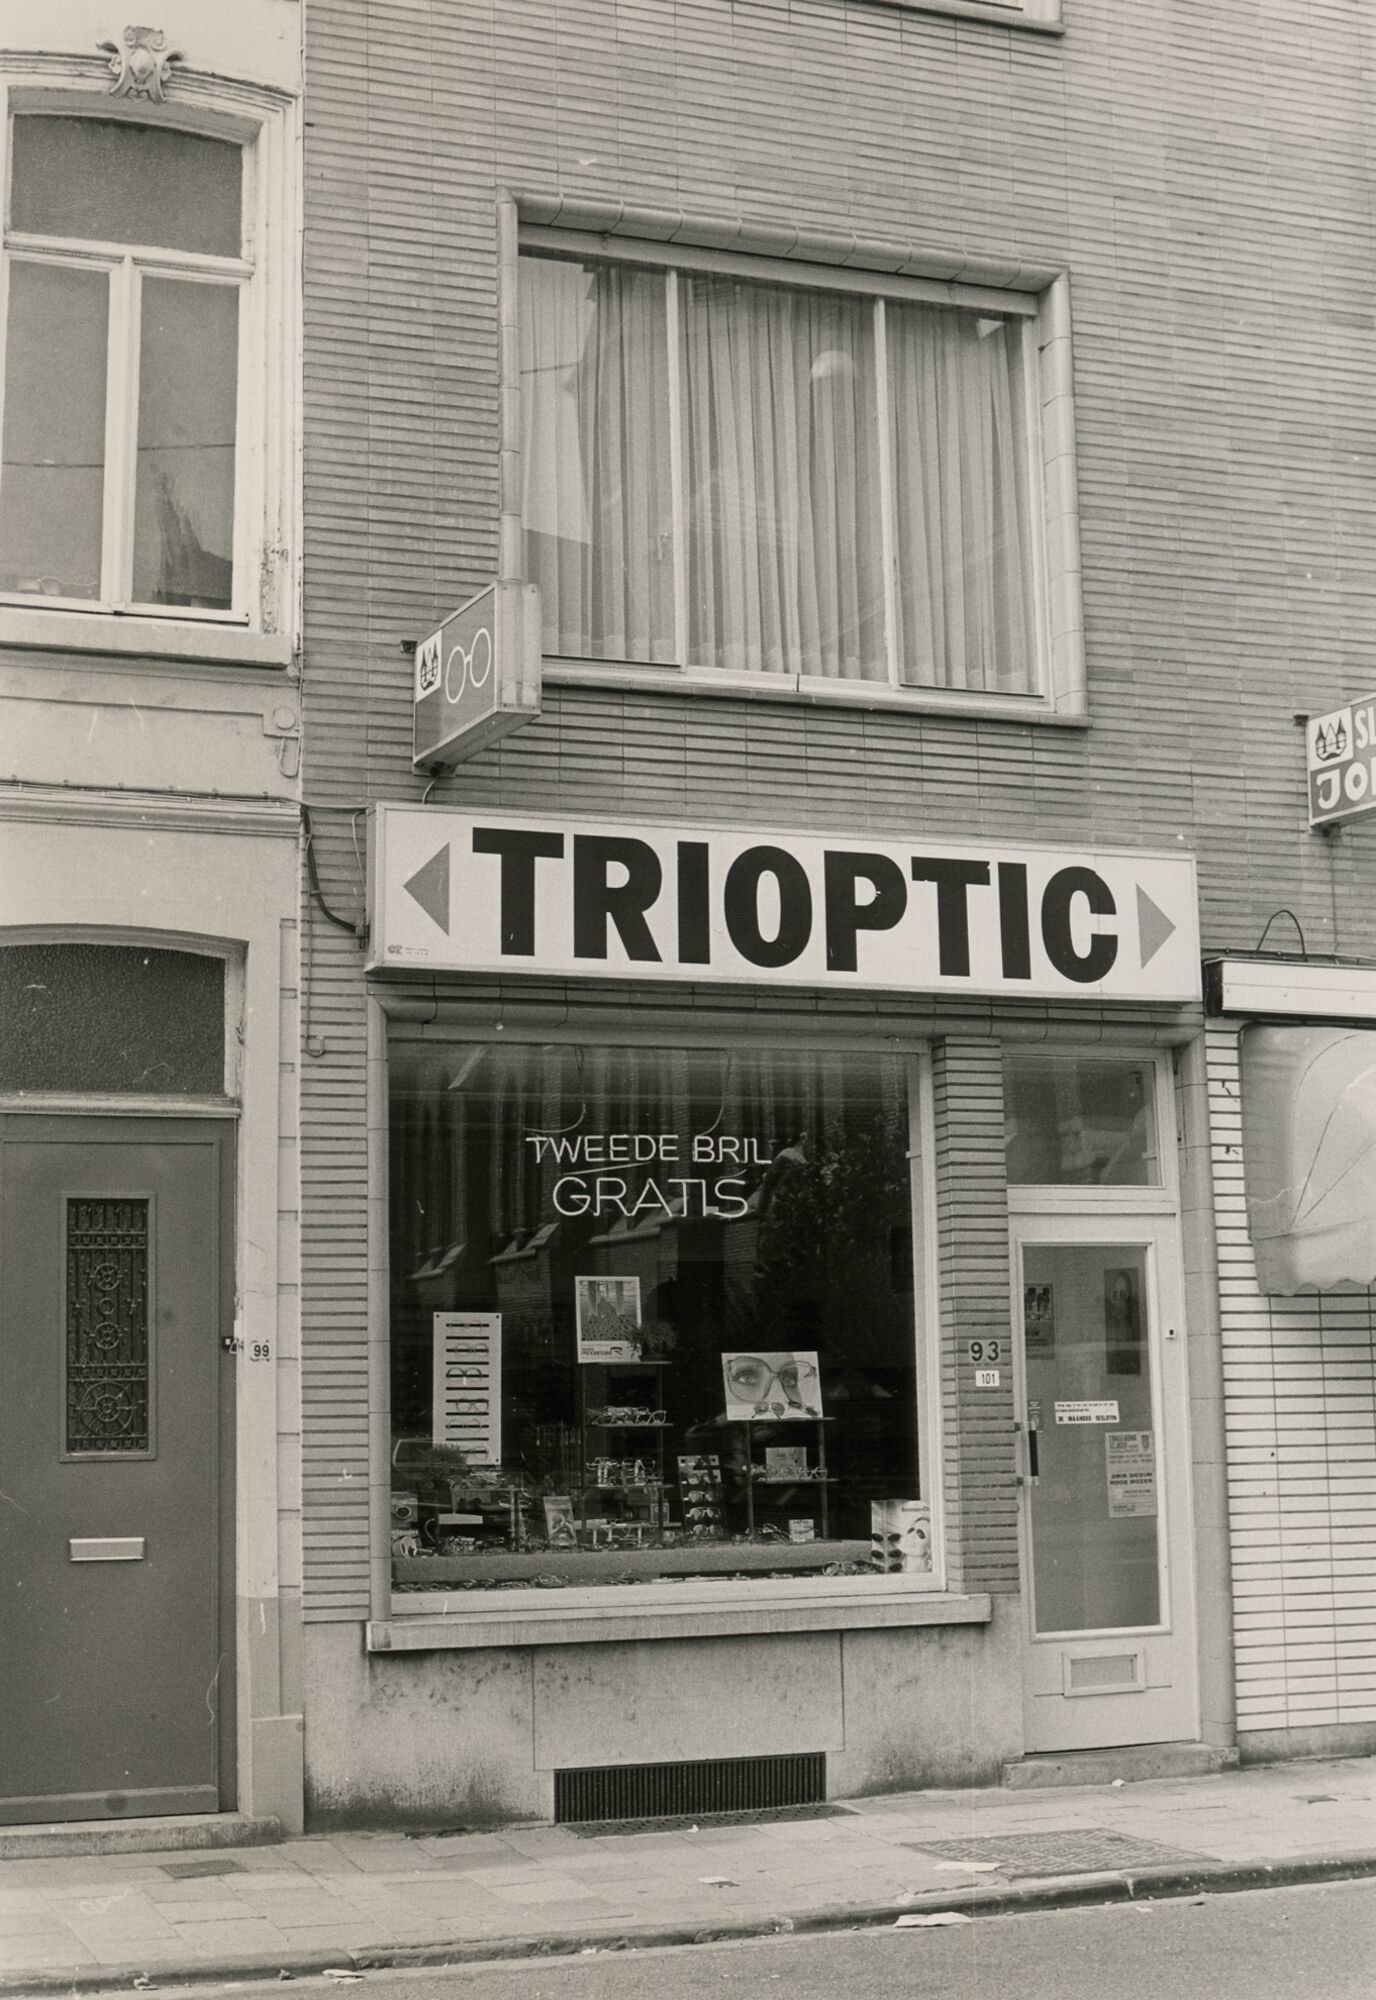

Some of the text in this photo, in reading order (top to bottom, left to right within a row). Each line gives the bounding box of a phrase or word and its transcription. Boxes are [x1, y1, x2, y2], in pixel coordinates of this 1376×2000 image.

[1316, 756, 1376, 809] JO
[472, 827, 1118, 984] TRIOPTIC
[526, 1134, 772, 1163] TWEEDE BRIL
[553, 1176, 748, 1217] GRATIS
[254, 1344, 269, 1357] 99
[971, 1341, 999, 1361] 93
[981, 1373, 995, 1385] 101
